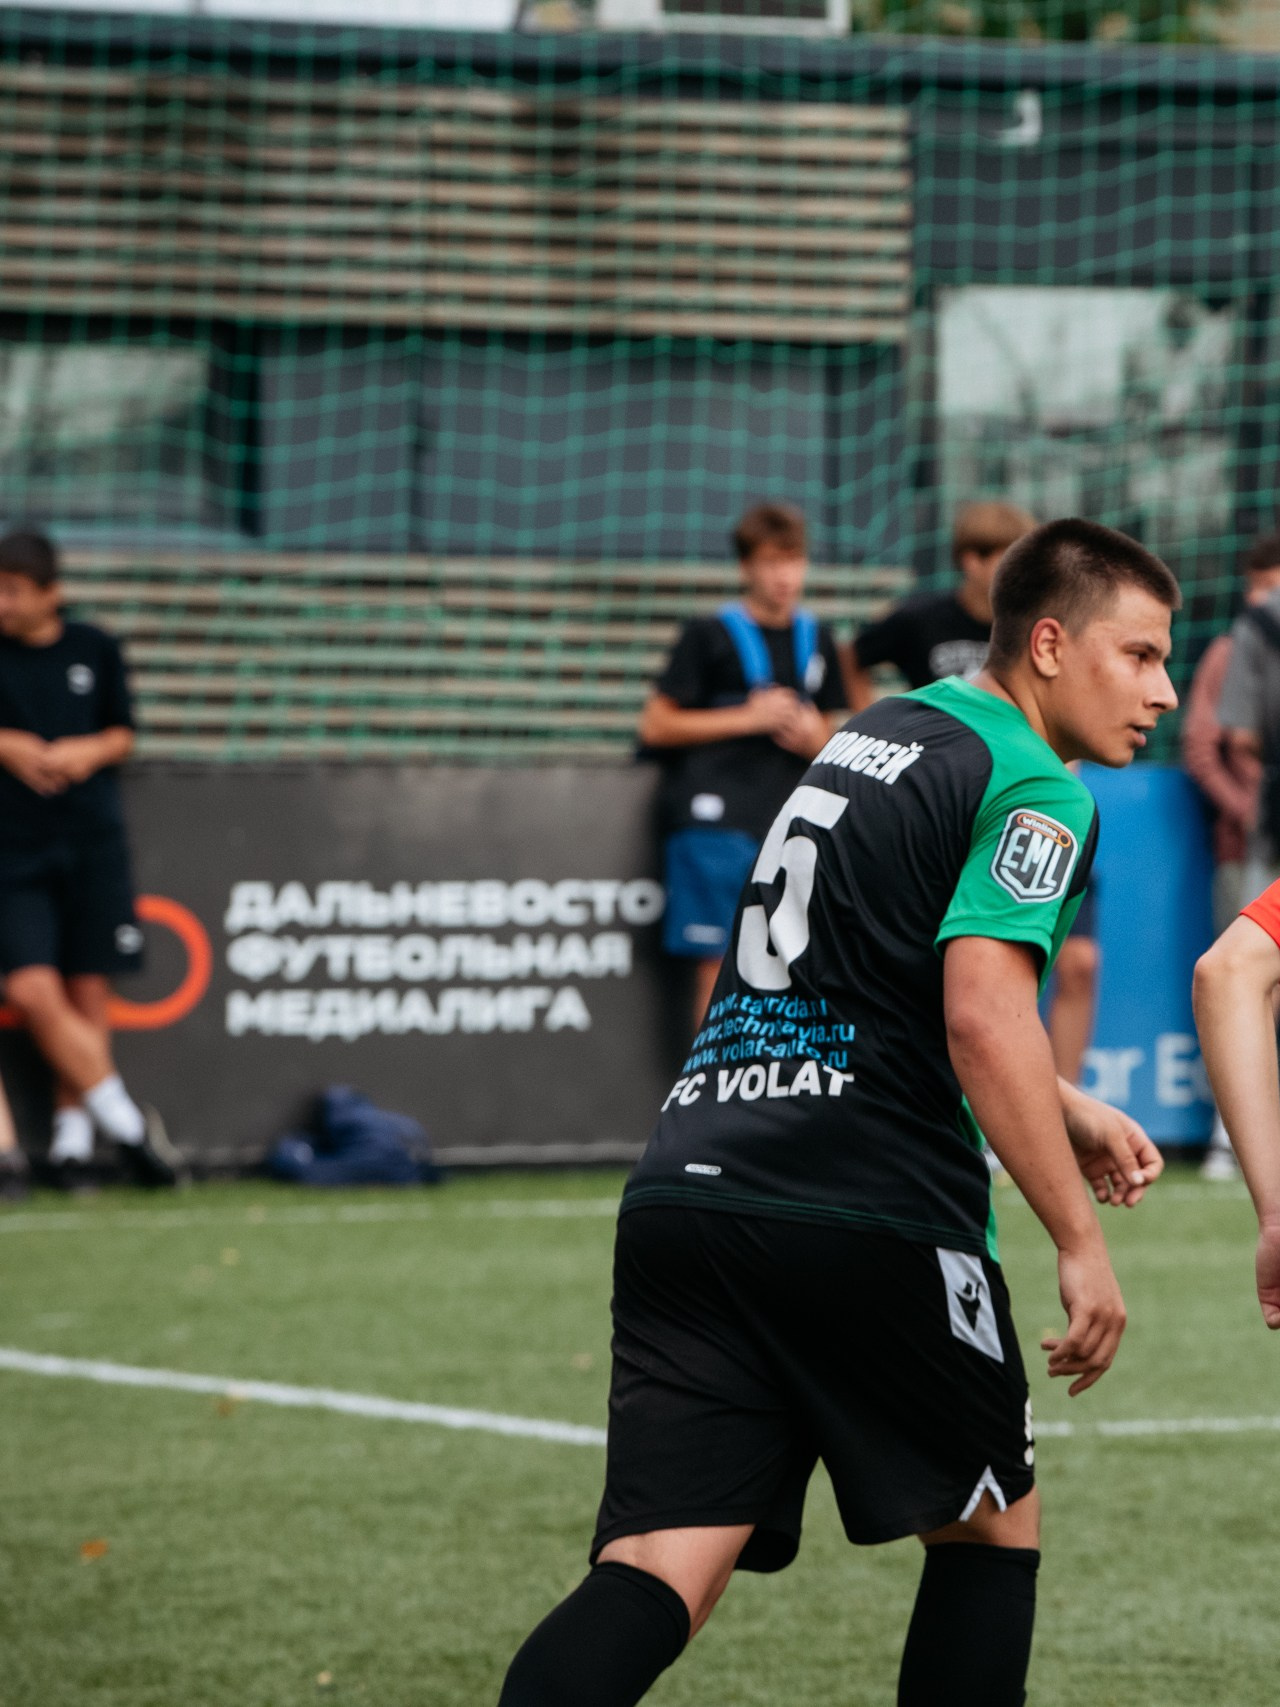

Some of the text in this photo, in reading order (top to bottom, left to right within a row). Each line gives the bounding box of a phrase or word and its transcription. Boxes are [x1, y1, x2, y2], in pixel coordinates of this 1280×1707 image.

[1000, 826, 1063, 891] EML
[737, 785, 849, 991] 5
[226, 932, 632, 982] ФУТБОЛЬНАЯ
[225, 985, 591, 1042] МЕДИАЛИГА
[661, 1060, 855, 1113] FC VOLAT
